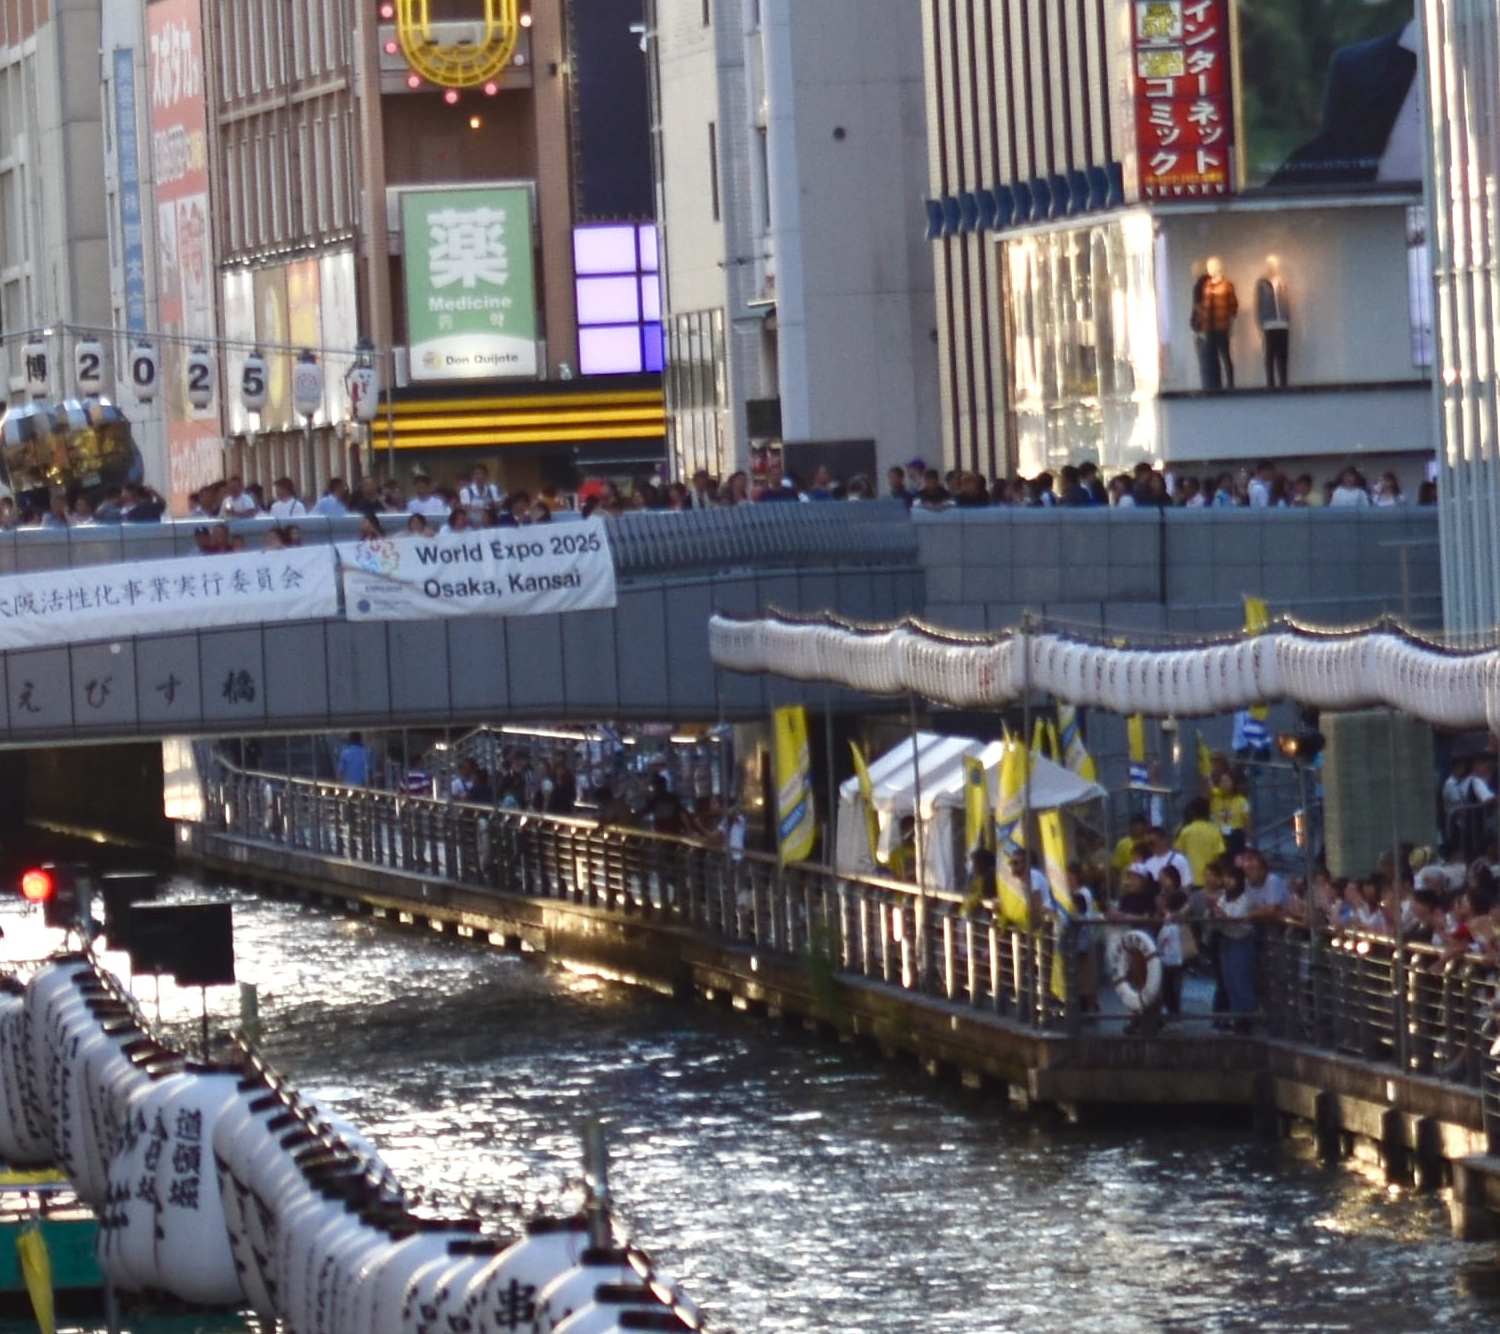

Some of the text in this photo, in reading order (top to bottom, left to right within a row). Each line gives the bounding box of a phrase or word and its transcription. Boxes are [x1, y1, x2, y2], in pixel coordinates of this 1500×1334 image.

[1184, 0, 1224, 175] インターネット
[1146, 77, 1180, 176] コミック
[427, 206, 508, 291] 薬
[427, 293, 513, 313] Medicine
[445, 351, 519, 368] Don Quijote
[415, 533, 601, 566] World Expo 2025
[423, 569, 582, 599] Osaka, Kansai
[17, 670, 257, 715] えびす橋
[169, 1108, 202, 1210] 道頓堀
